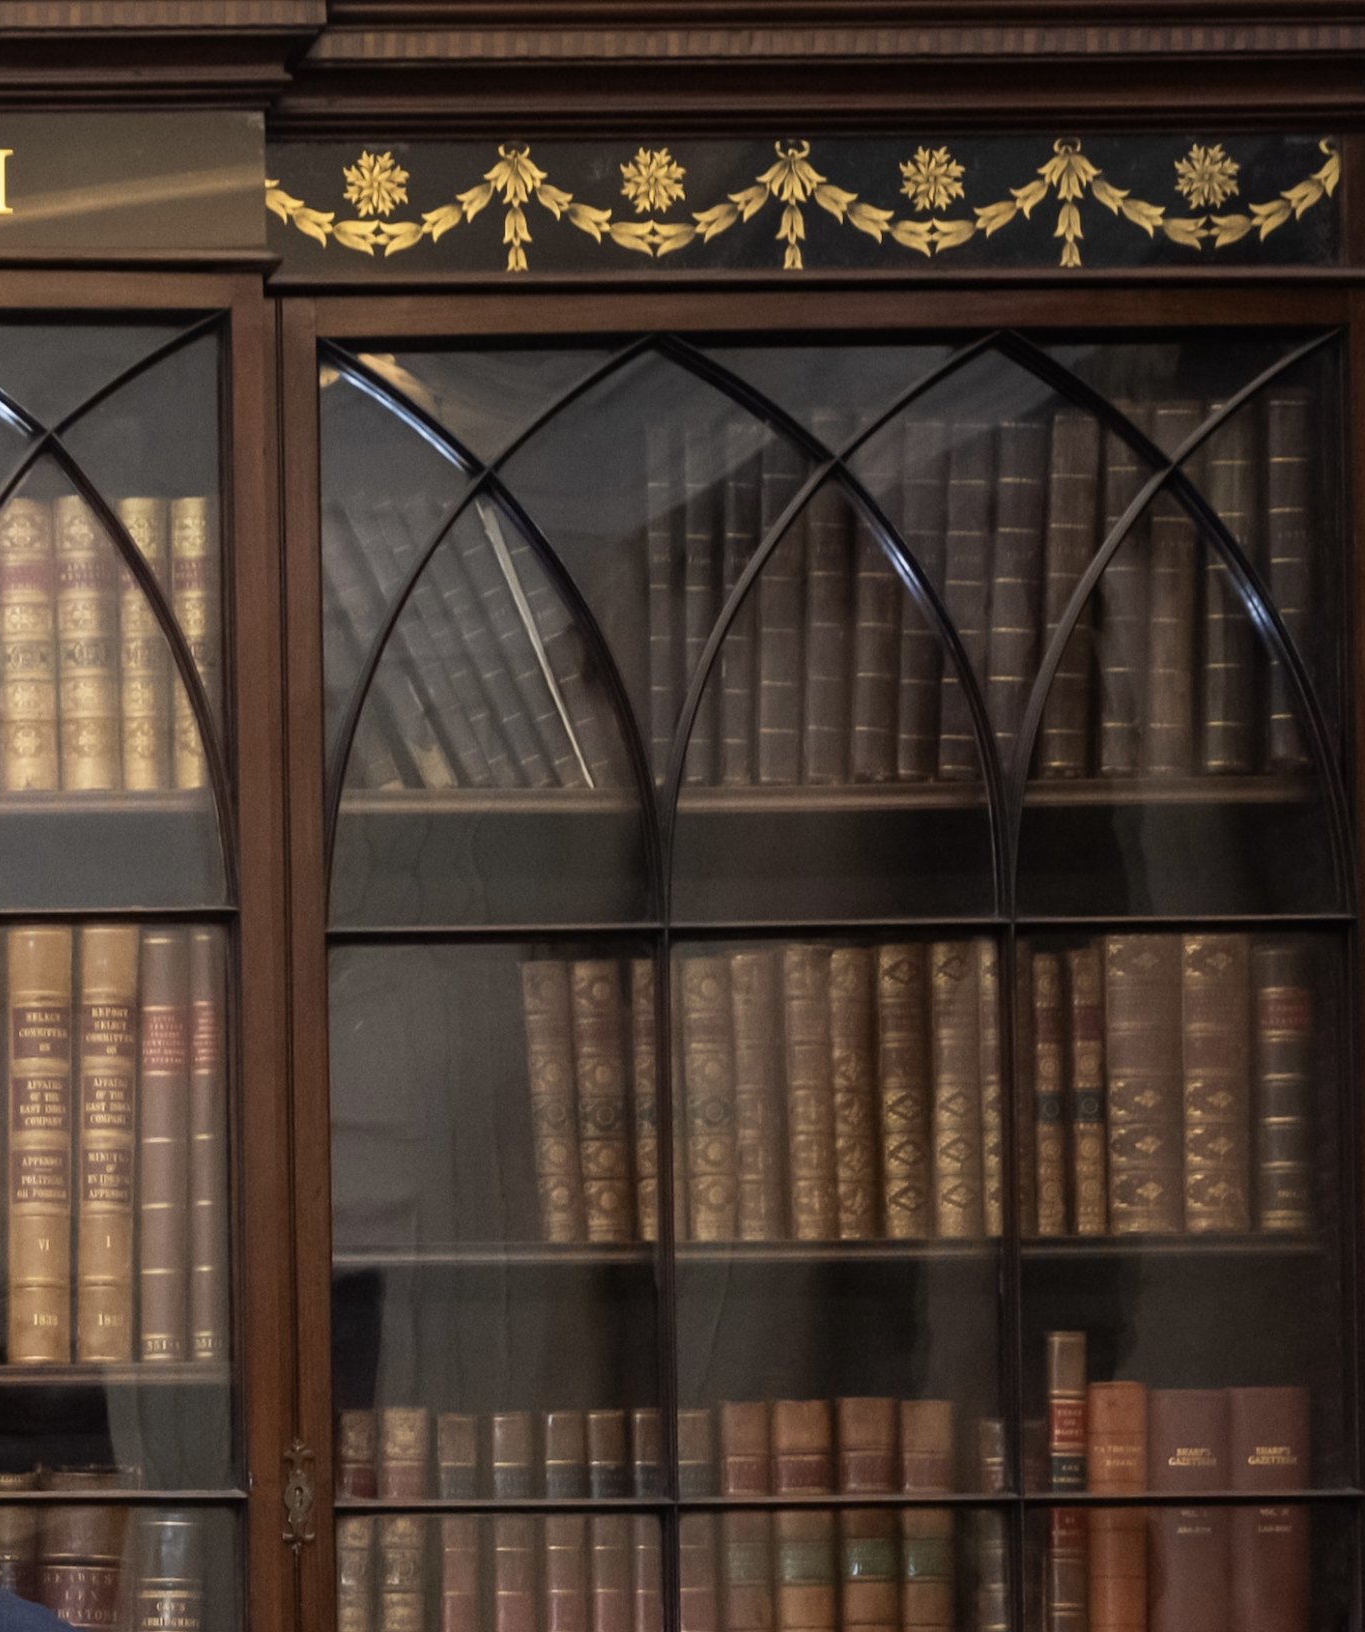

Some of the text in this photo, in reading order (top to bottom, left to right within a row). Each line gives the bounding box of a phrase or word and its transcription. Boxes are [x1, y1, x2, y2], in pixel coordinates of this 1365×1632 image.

[25, 1012, 62, 1023] SELECT
[91, 1007, 129, 1018] REPORT
[93, 1020, 127, 1031] SELECT
[18, 1027, 68, 1038] COMMITTEE
[85, 1033, 134, 1044] COMMITTEE
[26, 1079, 63, 1090] AFFAIRS
[93, 1077, 128, 1088] AFFAIRS
[30, 1092, 60, 1103] OF THE
[95, 1090, 124, 1100] OF THE
[20, 1104, 66, 1115] EAST INDIA
[85, 1102, 131, 1113] EAST INDIA
[24, 1116, 63, 1127] COMPANY
[89, 1114, 127, 1125] COMPANY
[22, 1156, 63, 1167] APPENDIX
[21, 1174, 63, 1186] POLITICAL
[38, 1238, 50, 1252] VI
[104, 1235, 112, 1249] I
[1168, 1456, 1218, 1466] GAZETTEER
[1247, 1455, 1298, 1465] GAZETTEER
